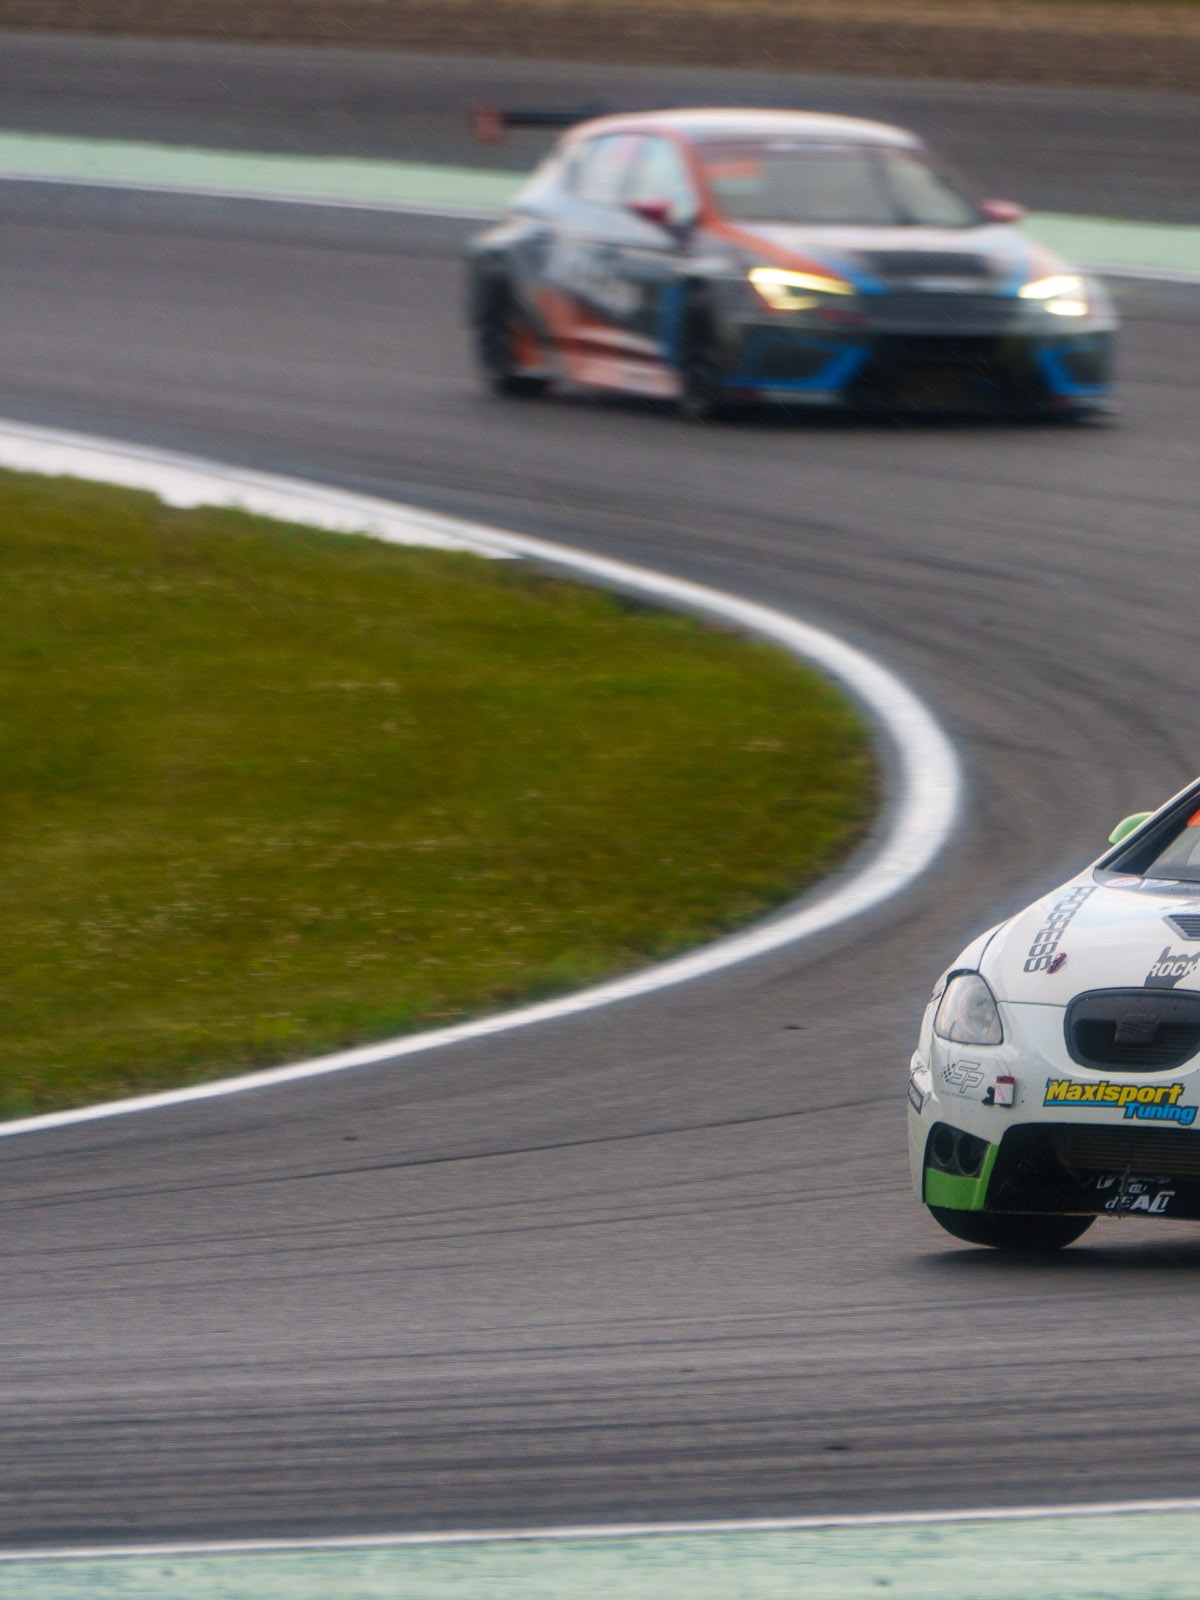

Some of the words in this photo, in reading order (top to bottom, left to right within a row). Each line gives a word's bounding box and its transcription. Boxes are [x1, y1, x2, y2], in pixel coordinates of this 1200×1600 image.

[1023, 886, 1098, 973] PROGRESS
[1150, 961, 1198, 977] ROCK
[1046, 1080, 1184, 1107] Maxisport
[1124, 1102, 1199, 1125] Tuning
